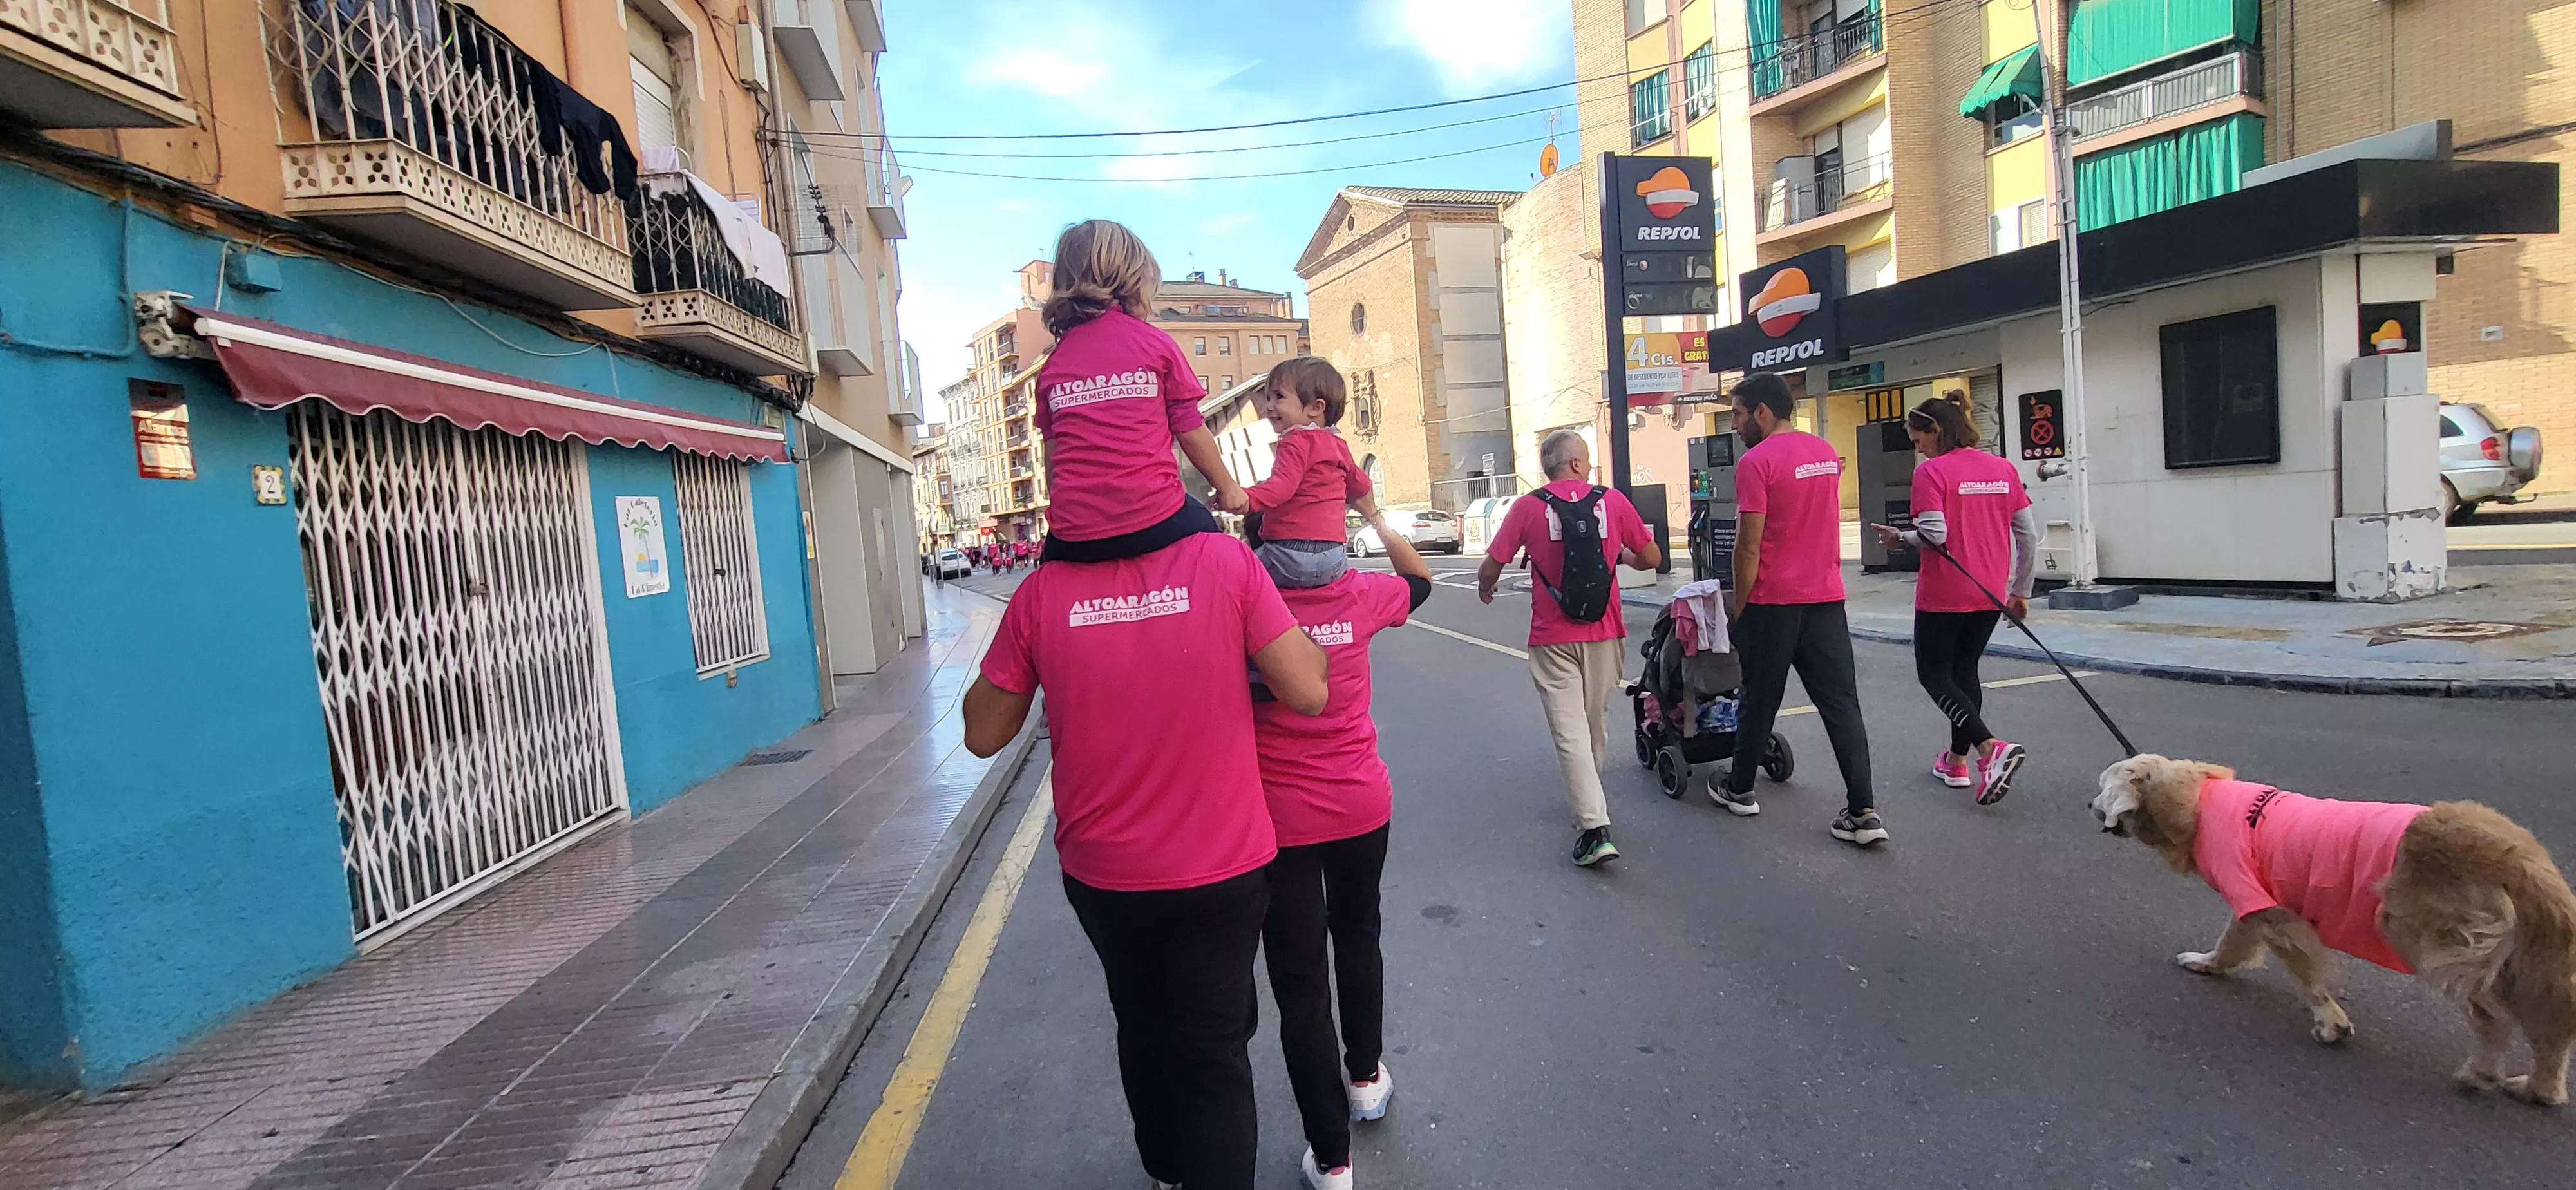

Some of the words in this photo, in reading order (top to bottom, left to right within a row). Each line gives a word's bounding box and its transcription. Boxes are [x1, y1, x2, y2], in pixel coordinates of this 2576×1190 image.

[1638, 227, 1701, 240] REPSOL
[1627, 337, 1649, 366] 4
[1651, 353, 1678, 366] Cts.
[1694, 337, 1705, 348] ES
[1751, 338, 1824, 369] REPSOL
[1050, 367, 1157, 398] ALTOARAGÓN
[1054, 387, 1149, 407] SUPERMERCADOS
[265, 475, 275, 494] 2
[1069, 585, 1189, 614] ALTOARAGÓN
[1082, 603, 1177, 623] SUPERMERCADOS
